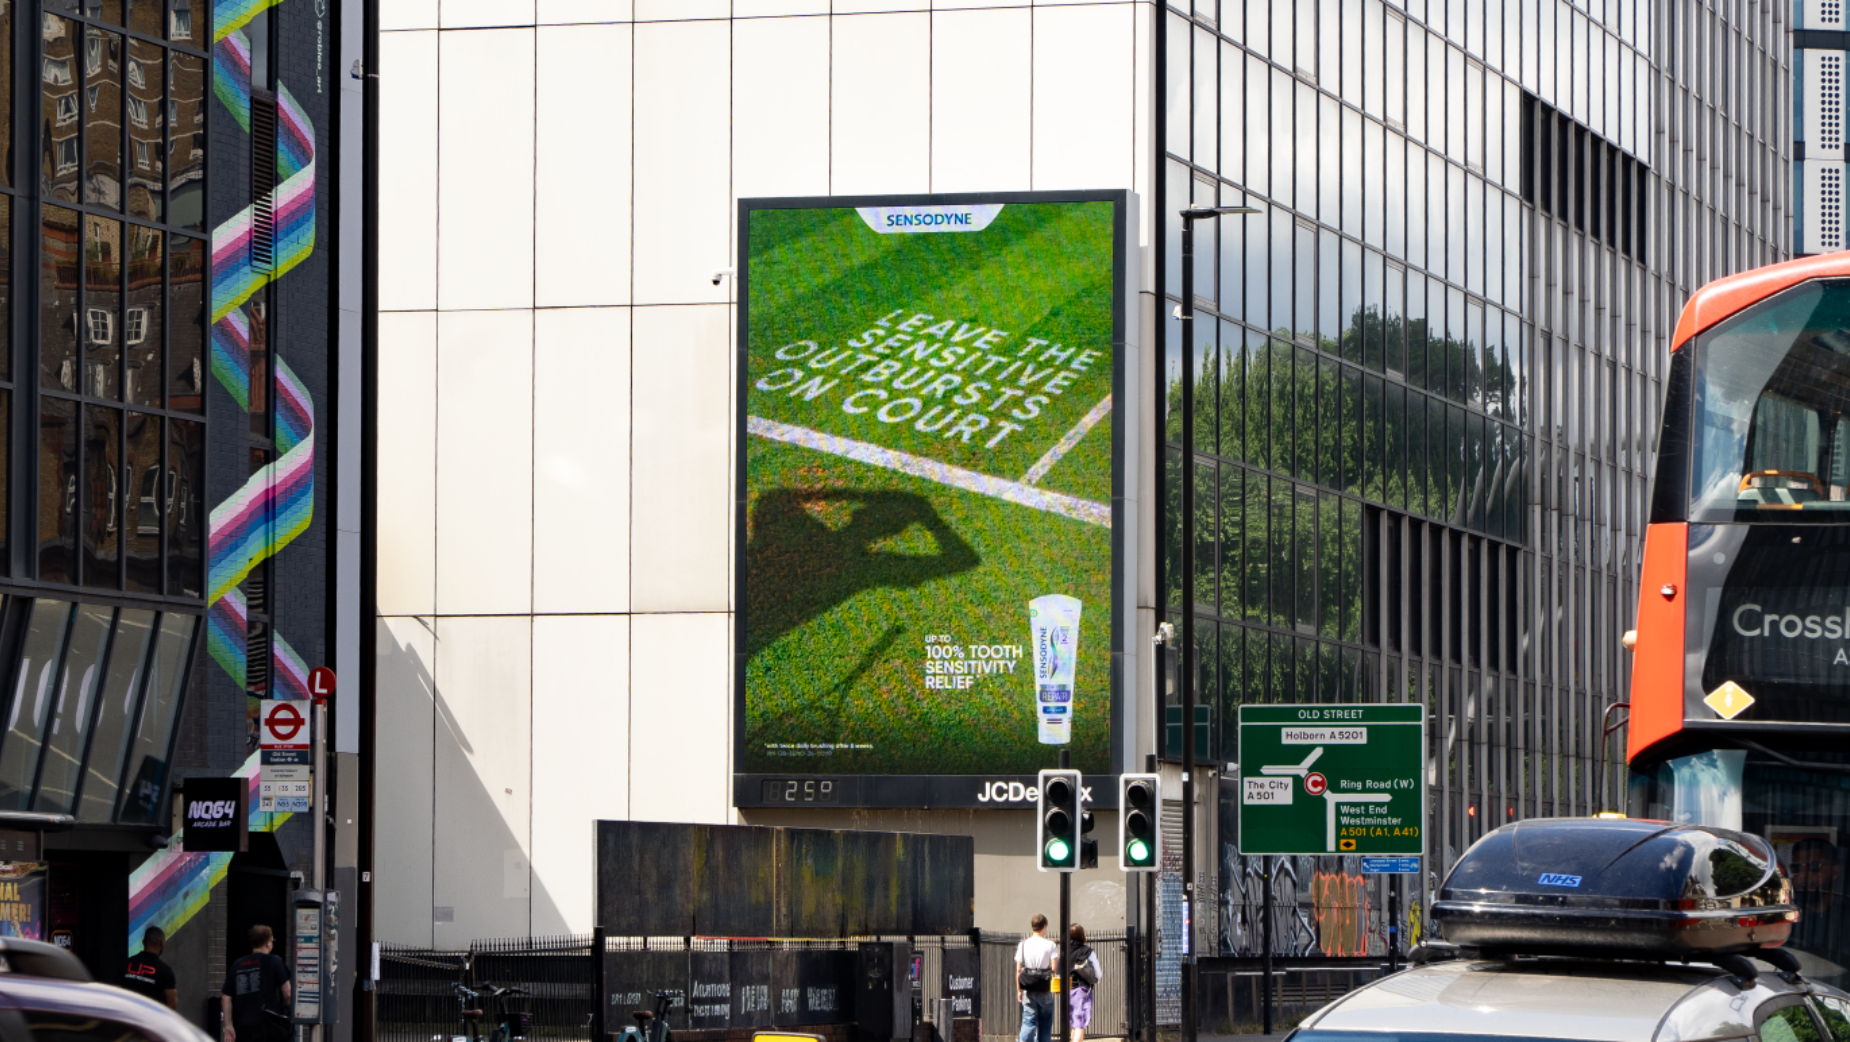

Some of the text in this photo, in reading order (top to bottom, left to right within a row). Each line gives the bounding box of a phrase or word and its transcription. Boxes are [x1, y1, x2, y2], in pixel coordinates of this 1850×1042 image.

[886, 212, 972, 227] SENSODYNE
[876, 309, 1103, 372] LEAVE THE
[847, 328, 1080, 395] SENSITIVE
[774, 340, 1050, 420] OUTBURSTS
[755, 367, 1025, 450] ON COURT
[924, 634, 952, 644] UP TO
[924, 644, 1024, 660] 100% TOOTH
[1039, 626, 1048, 679] SENSODYNE
[1833, 647, 1850, 666] A
[924, 659, 1017, 675] SENSITIVITY
[314, 671, 328, 695] L
[1042, 692, 1069, 702] REPAIR
[1297, 709, 1364, 720] OLD STREET
[1284, 731, 1326, 741] Holborn
[1247, 780, 1290, 791] The City
[1340, 778, 1415, 790] Ring Road (W)
[977, 781, 1094, 803] JCDex
[187, 800, 237, 820] NQ64
[1340, 805, 1388, 815] West End
[191, 820, 232, 829] ARCADE BAR
[1340, 816, 1403, 826] Westminster
[1369, 826, 1391, 838] (A1,
[1540, 873, 1579, 886] NHS
[126, 962, 157, 977] UP
